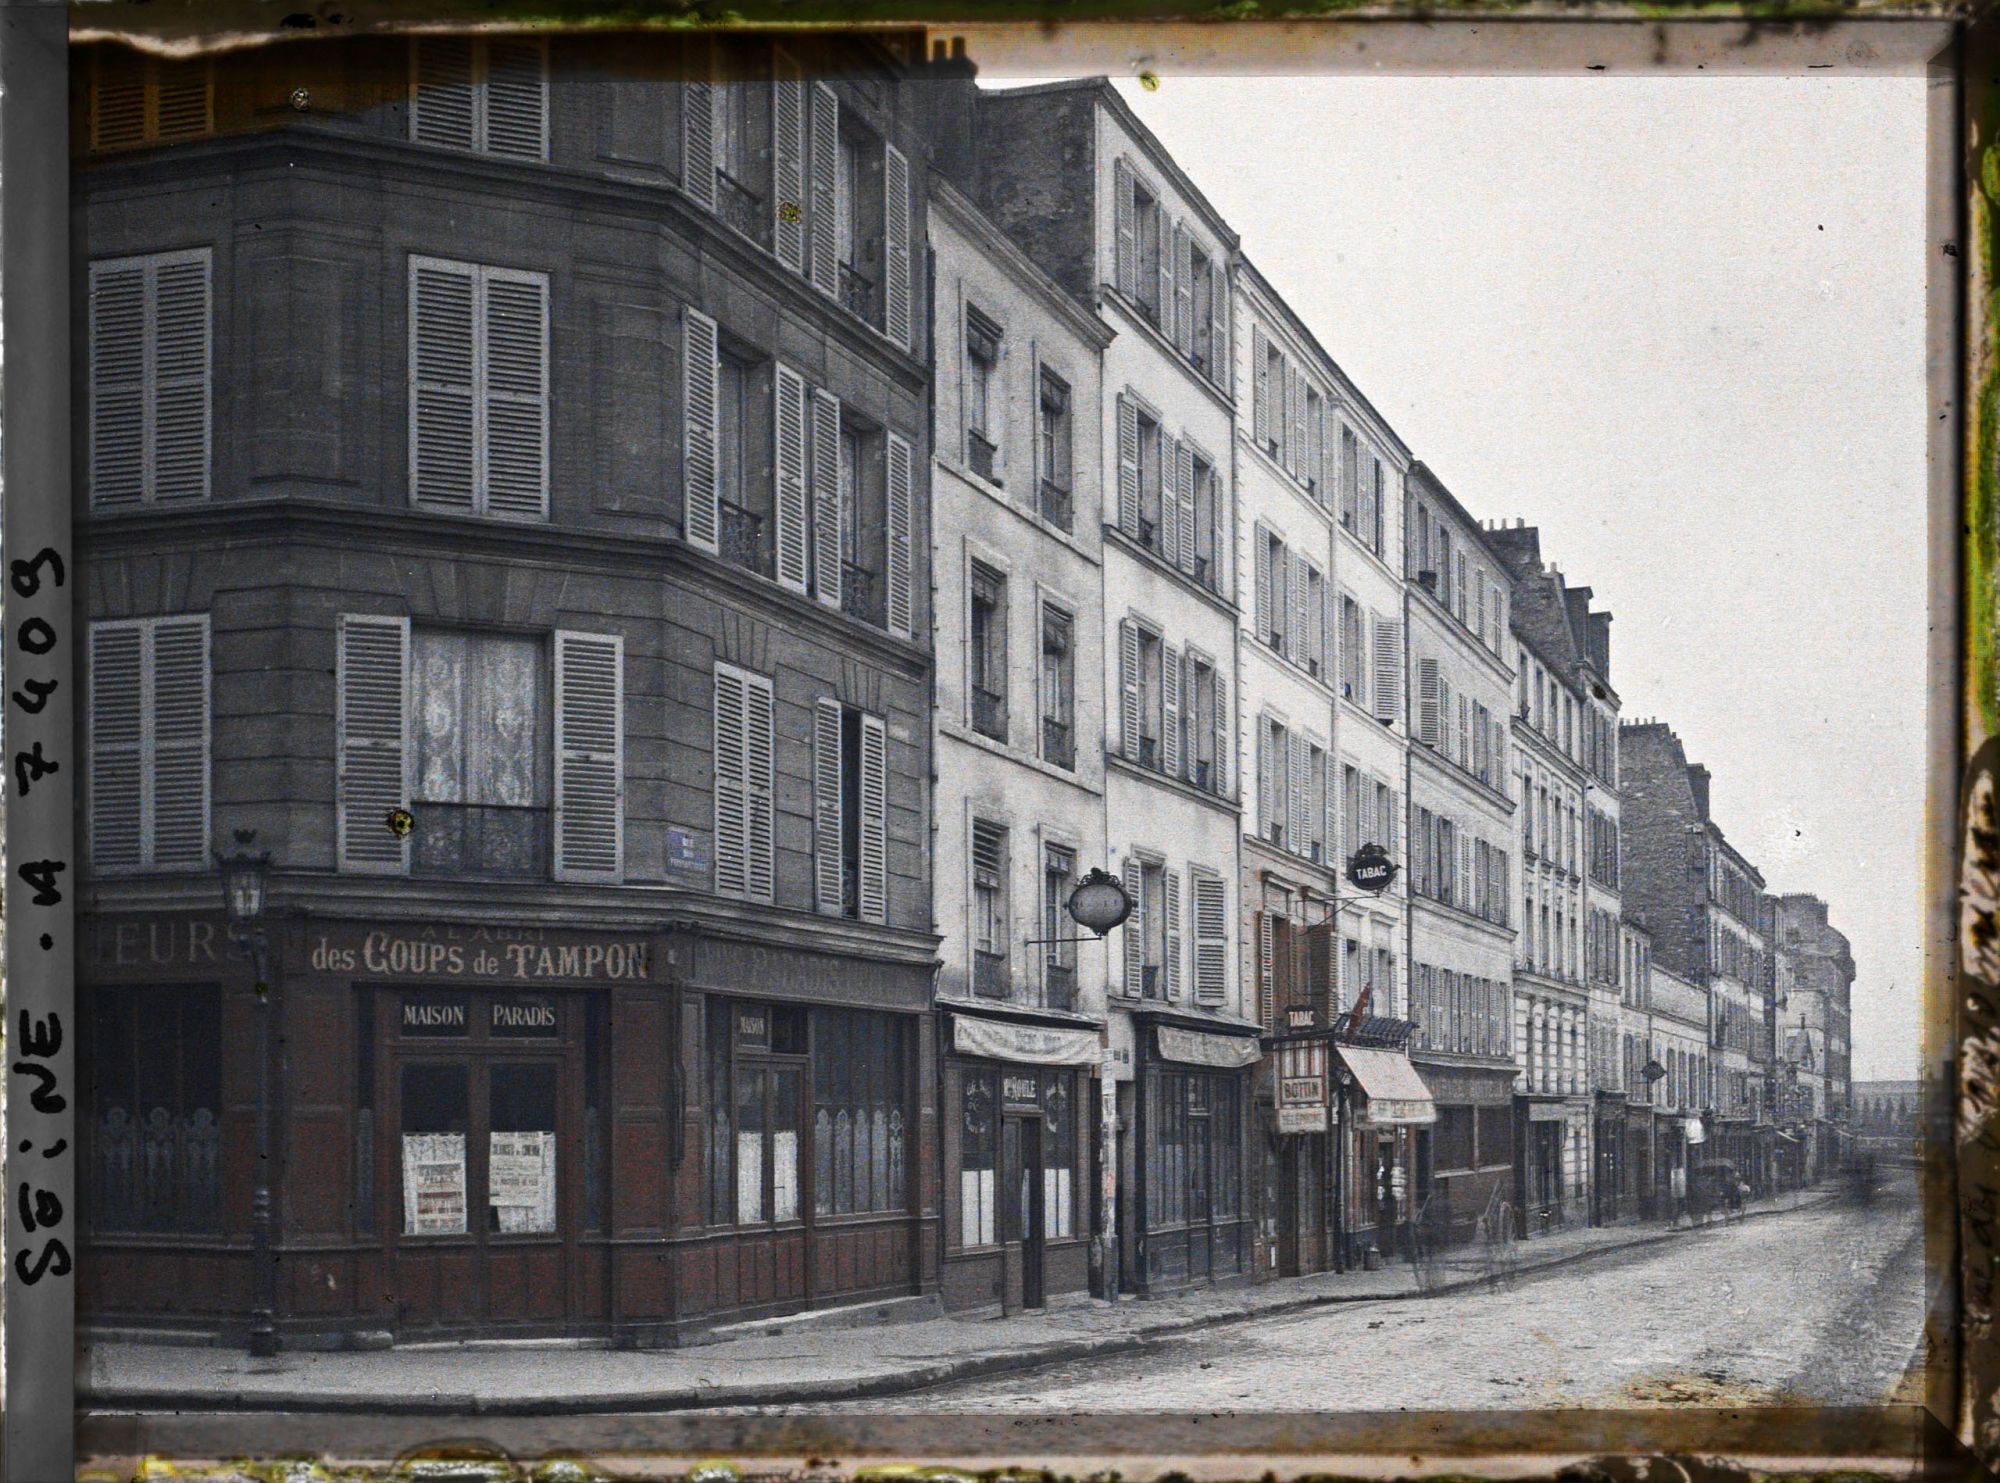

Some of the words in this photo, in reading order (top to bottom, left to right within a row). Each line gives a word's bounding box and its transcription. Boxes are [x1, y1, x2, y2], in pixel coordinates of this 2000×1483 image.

[1356, 866, 1387, 881] TABAC
[311, 937, 356, 972] des
[473, 949, 499, 975] de
[505, 943, 649, 979] TAMPON
[403, 1004, 465, 1027] MAISON
[492, 1004, 556, 1028] PARADIS
[1288, 1010, 1315, 1028] TABAC
[1283, 1081, 1319, 1099] BOTTIN
